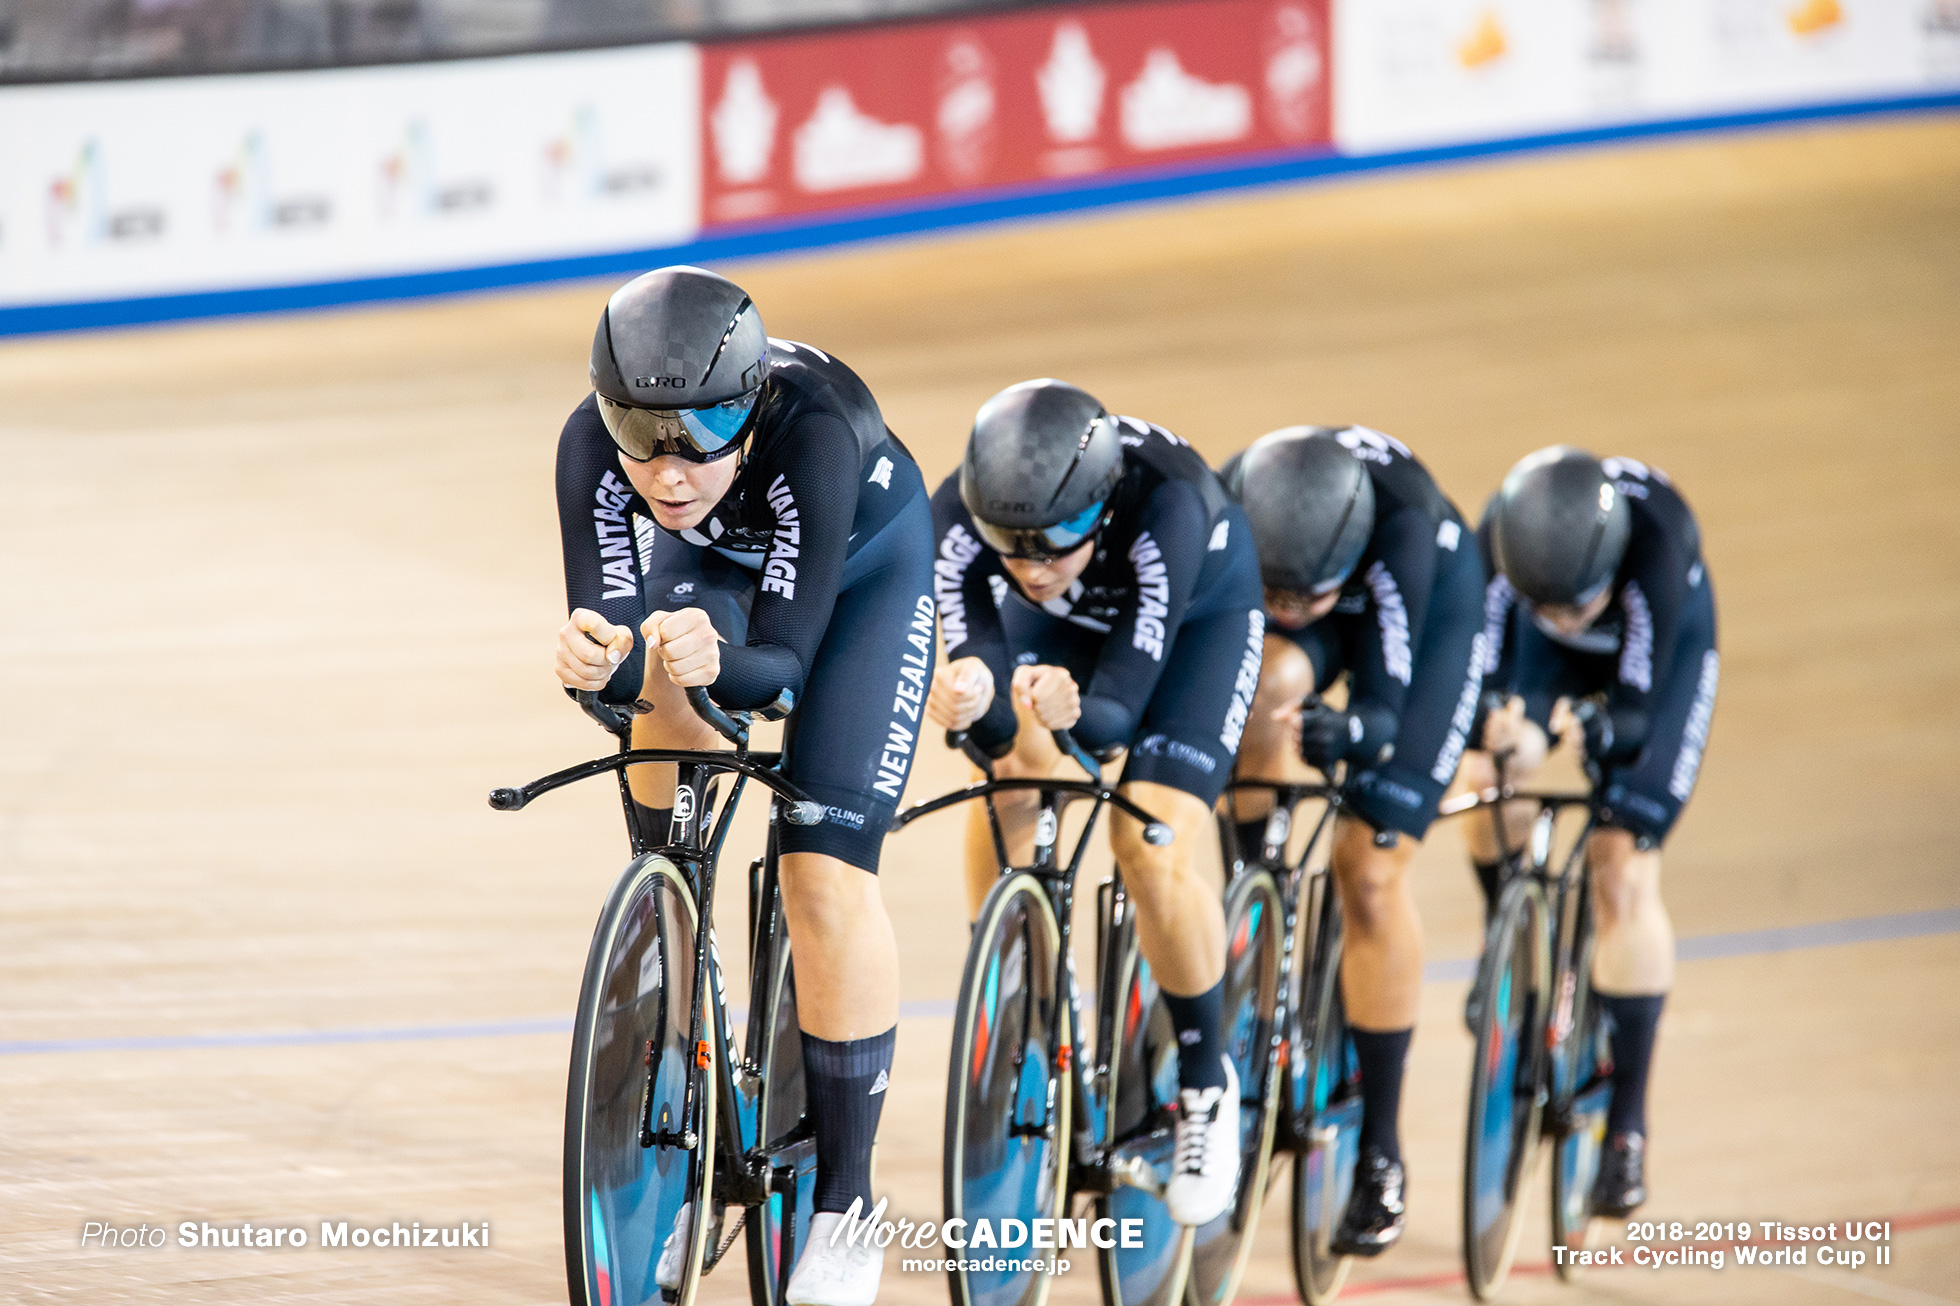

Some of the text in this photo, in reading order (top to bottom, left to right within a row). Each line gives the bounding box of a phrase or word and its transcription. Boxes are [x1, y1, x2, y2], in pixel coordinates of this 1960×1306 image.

[635, 376, 687, 389] GIRO
[593, 469, 637, 601] VANTAGE
[761, 474, 801, 601] VANTAGE
[934, 522, 983, 654] VANTAGE
[1127, 530, 1170, 663] VANTAGE
[873, 595, 935, 798] NEW ZEALAND
[1219, 692, 1249, 756] NEW
[822, 804, 866, 826] YCLING
